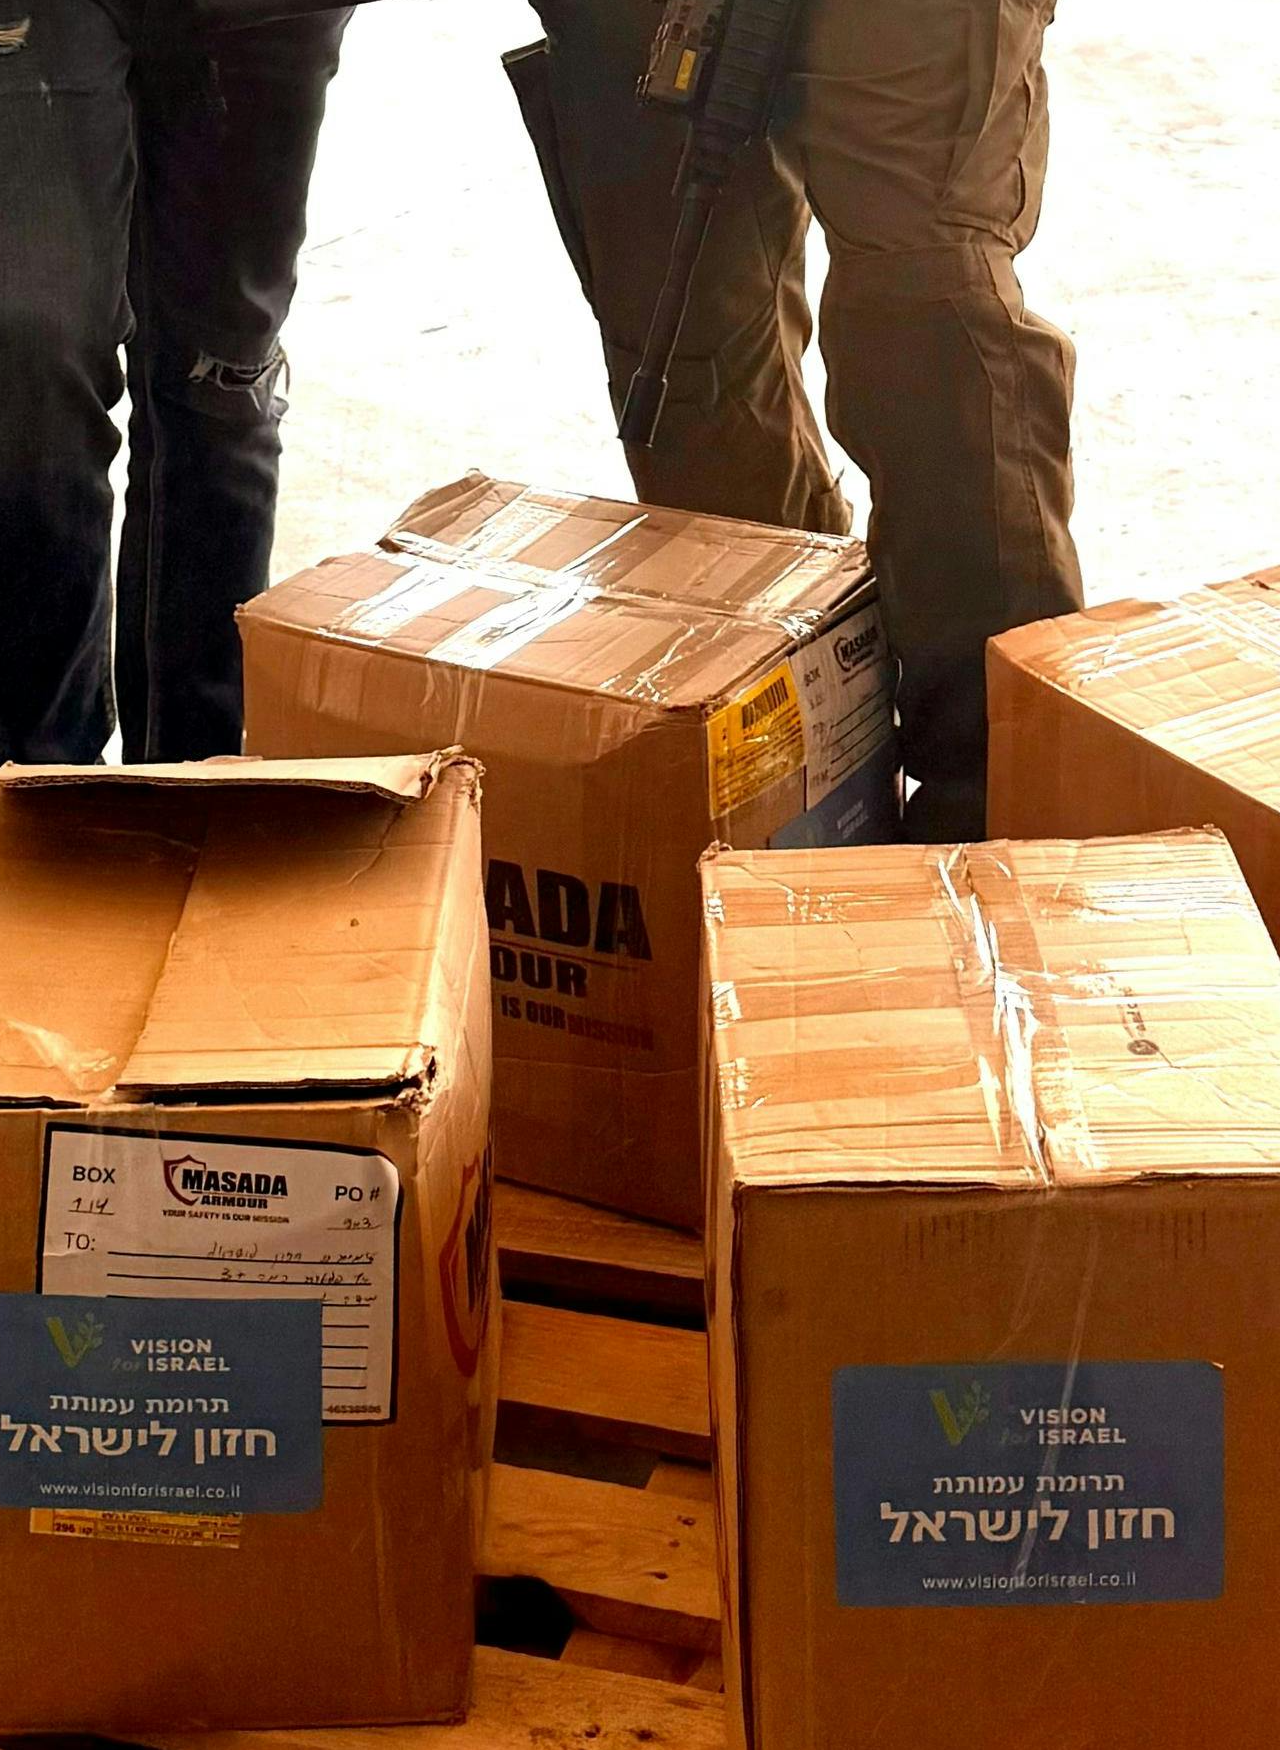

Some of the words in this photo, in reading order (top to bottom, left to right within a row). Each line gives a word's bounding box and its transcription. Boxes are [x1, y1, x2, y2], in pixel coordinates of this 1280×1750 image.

[484, 858, 653, 961] ADA
[490, 944, 588, 998] OUR
[501, 994, 521, 1019] IS
[526, 1000, 567, 1030] OUR
[72, 1165, 116, 1184] BOX
[181, 1168, 288, 1197] MASADA
[201, 1195, 268, 1209] ARMOUR
[335, 1185, 364, 1202] PO
[369, 1186, 380, 1202] #
[222, 1213, 231, 1221] IS
[64, 1231, 96, 1251] TO:
[131, 1338, 212, 1355] VISION
[147, 1356, 231, 1373] ISRAEL
[49, 1394, 135, 1415] עמותת
[146, 1397, 229, 1414] תרומת
[1019, 1408, 1106, 1425] VISION
[1, 1414, 178, 1457] לישראל
[1038, 1428, 1127, 1445] ISRAEL
[195, 1429, 277, 1464] חזון
[39, 1481, 241, 1499] www.visionforisrael.co.il
[932, 1474, 1025, 1494] עמותת
[1036, 1473, 1125, 1492] תרומת
[880, 1499, 1070, 1543] לישראל
[1088, 1506, 1175, 1549] חזון
[922, 1571, 1136, 1590] www.visionforisrael.co.il
